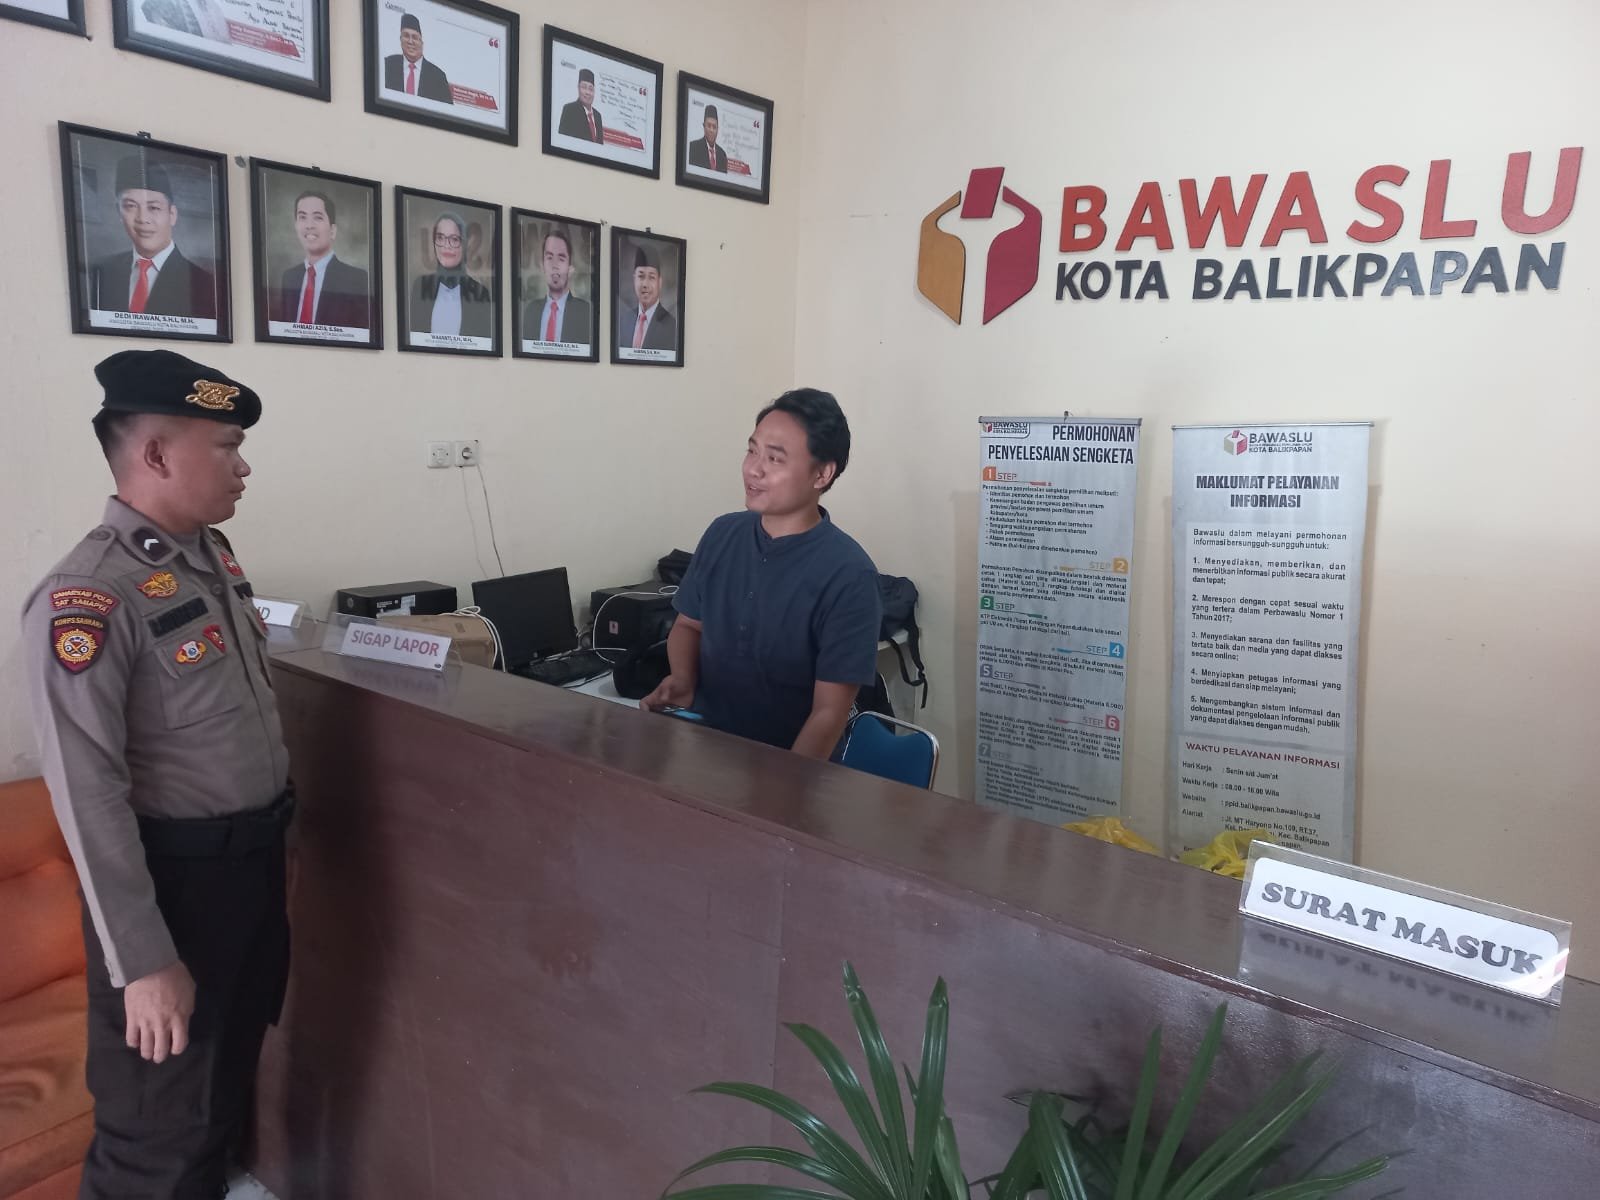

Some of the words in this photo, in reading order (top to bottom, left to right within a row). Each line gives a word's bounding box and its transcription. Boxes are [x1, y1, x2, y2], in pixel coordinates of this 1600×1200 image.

[1058, 146, 1584, 253] BAWASLU
[1055, 259, 1170, 301] KOTA
[1192, 242, 1566, 300] BALIKPAPAN
[1052, 425, 1135, 442] PERMOHONAN
[1250, 432, 1313, 443] BAWASLU
[988, 445, 1070, 462] PENYELESAIAN
[1072, 447, 1134, 464] SENGKETA
[1268, 446, 1313, 454] BALIKPAPAN
[988, 469, 992, 479] 1
[998, 472, 1017, 480] STEP
[1196, 476, 1265, 489] MAKLUMAT
[1267, 476, 1340, 490] PELAYANAN
[1230, 494, 1301, 508] INFORMASI
[1229, 529, 1252, 537] dalam
[1256, 530, 1292, 540] melayani
[1296, 531, 1347, 540] permohonan
[1193, 538, 1226, 546] informasi
[1227, 539, 1304, 550] bersungguh-sungguh
[1305, 542, 1329, 550] untuk:
[1118, 561, 1125, 572] 2
[1205, 558, 1262, 568] Menyediakan,
[1267, 560, 1324, 570] memberikan,
[1192, 567, 1236, 576] menerbitkan
[1236, 568, 1270, 577] informasi
[1272, 570, 1294, 579] publik
[1295, 572, 1320, 580] secara
[1321, 572, 1346, 580] akurat
[984, 597, 991, 608] 3
[1192, 594, 1199, 602] 2.
[1202, 595, 1236, 604] Merespon
[1240, 597, 1266, 606] dengan
[1270, 599, 1290, 608] cepat
[1294, 601, 1318, 609] sesuai
[1322, 602, 1344, 610] waktu
[1192, 604, 1209, 613] yang
[1212, 605, 1236, 613] tertera
[1239, 606, 1260, 615] dalam
[1264, 608, 1306, 618] Perbawaslu
[1310, 611, 1336, 620] Nomor
[1192, 613, 1213, 621] Tahun
[1214, 614, 1233, 623] 2017;
[351, 630, 392, 648] SIGAP
[394, 636, 440, 656] LAPOR
[1200, 632, 1246, 642] Menyediakan
[1248, 636, 1273, 645] sarana
[1293, 638, 1321, 648] fasilitas
[1324, 643, 1343, 652] yang
[1086, 645, 1108, 654] STEP
[1112, 645, 1121, 656] 4
[1191, 641, 1214, 649] tertata
[1216, 642, 1230, 650] baik
[1248, 645, 1269, 654] media
[1270, 648, 1289, 656] yang
[1292, 648, 1312, 657] dapat
[1313, 651, 1343, 660] diakses
[1191, 650, 1214, 658] secara
[984, 665, 991, 676] 5
[994, 671, 1014, 679] STEP
[1191, 668, 1198, 676] 4.
[1201, 669, 1244, 680] Menyiapkan
[1248, 674, 1278, 683] petugas
[1282, 676, 1318, 687] informasi
[1322, 682, 1342, 690] yang
[1191, 678, 1231, 688] berdedikasi
[1245, 682, 1260, 691] siap
[1200, 696, 1258, 710] Mengembangkan
[1262, 704, 1286, 712] sistem
[1290, 705, 1323, 716] informasi
[1108, 717, 1116, 727] 6
[1190, 705, 1234, 716] dokumentasi
[1236, 710, 1280, 720] pengelolaan
[1282, 714, 1315, 725] informasi
[1317, 719, 1340, 728] publik
[1190, 714, 1207, 722] yang
[1207, 716, 1227, 724] dapat
[1228, 718, 1255, 728] diakses
[1256, 722, 1282, 731] dengan
[1185, 742, 1220, 753] WAKTU
[1223, 747, 1281, 761] PELAYANAN
[1284, 754, 1340, 769] INFORMASI
[1261, 882, 1386, 932] SURAT
[1392, 916, 1543, 975] MASUK
